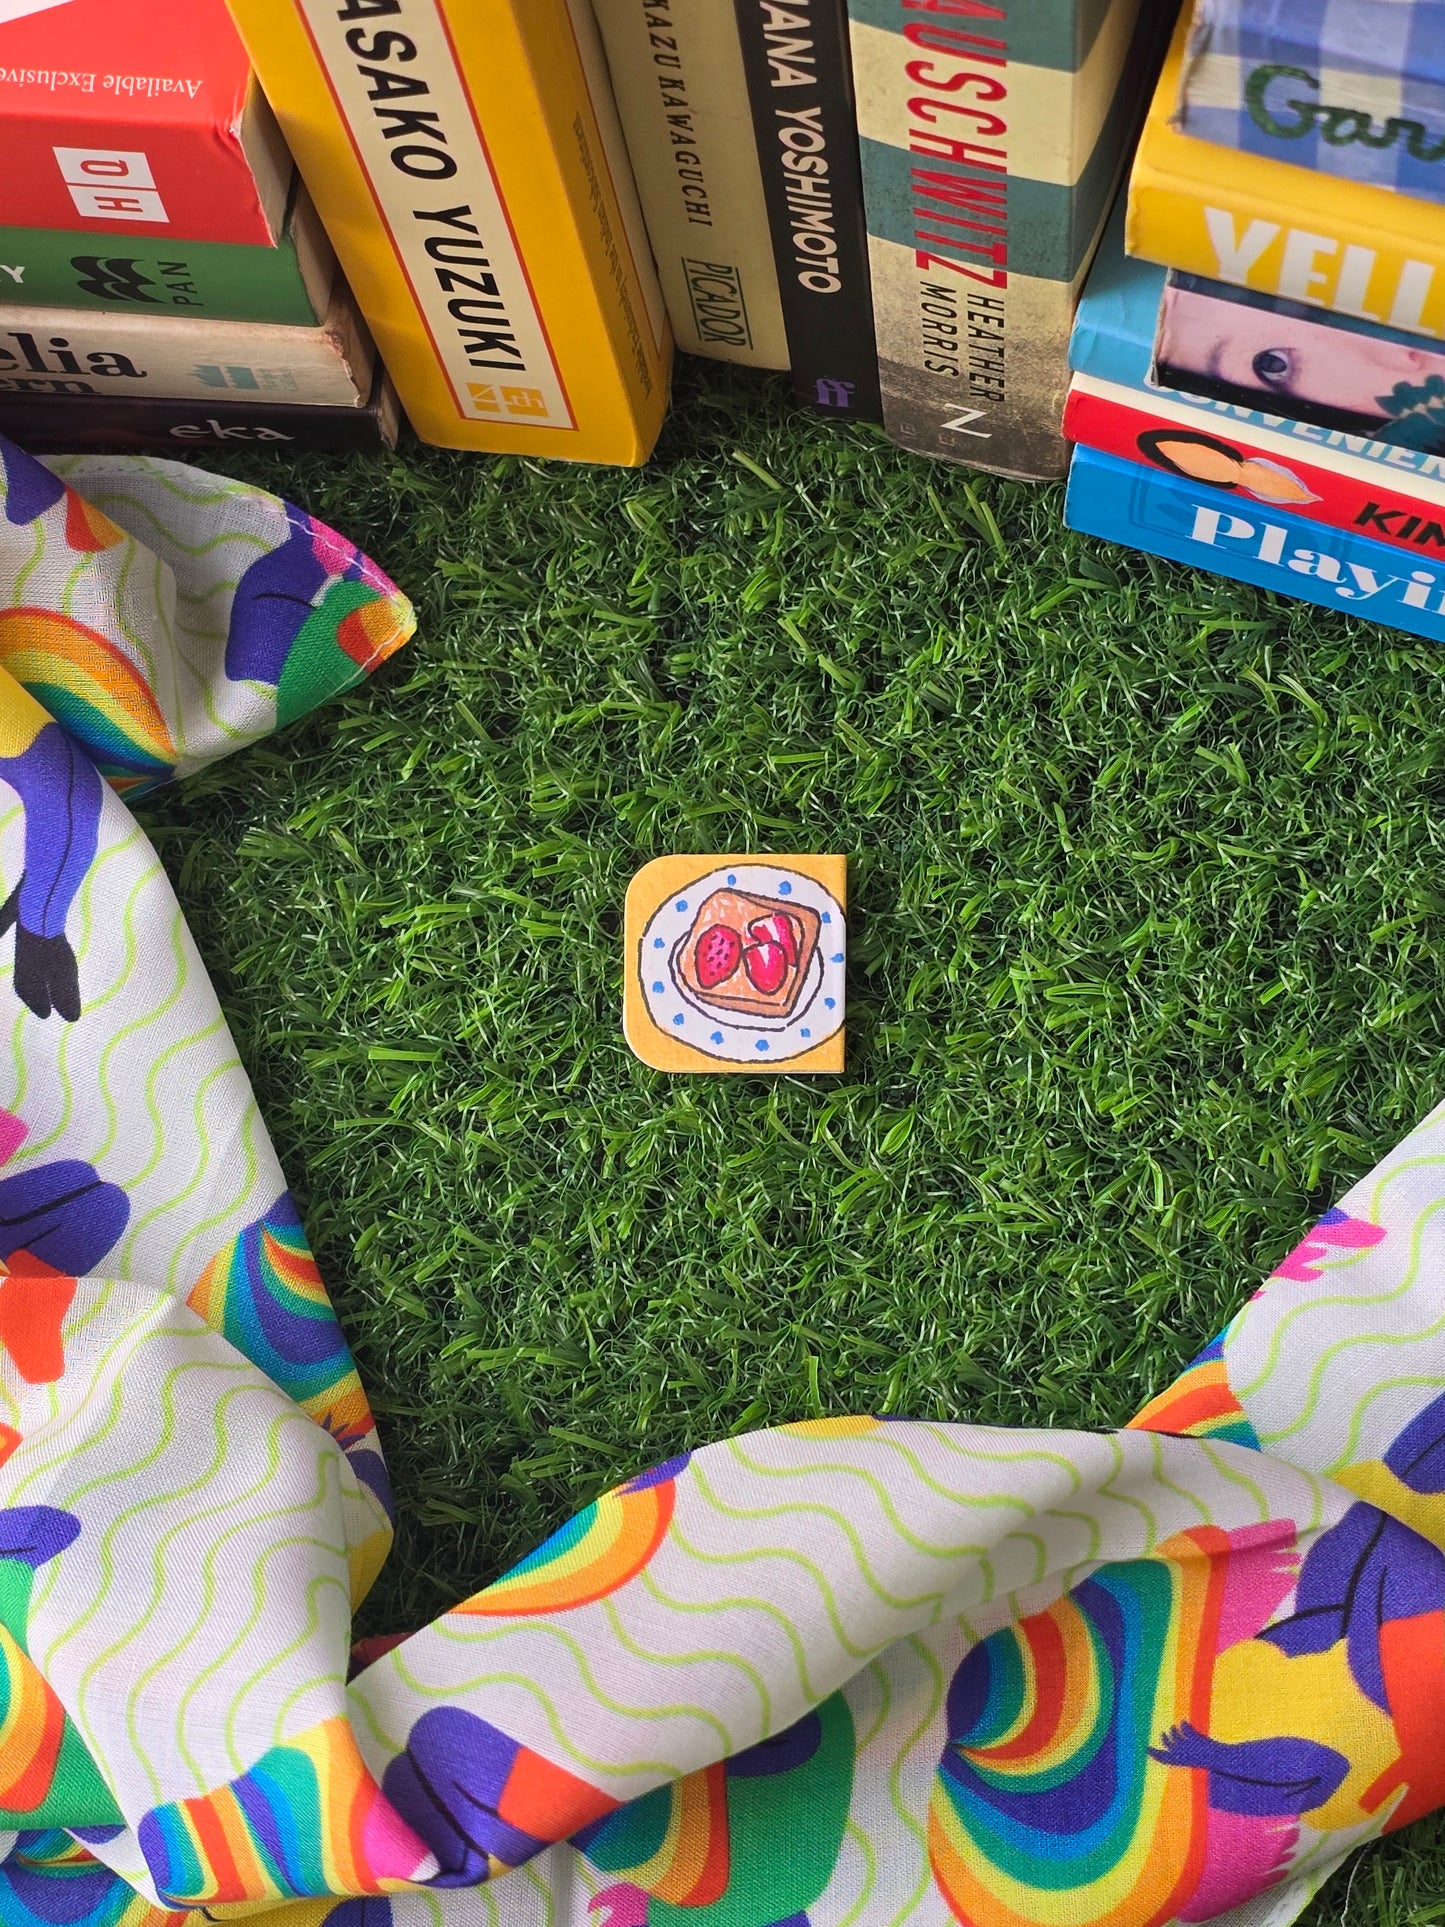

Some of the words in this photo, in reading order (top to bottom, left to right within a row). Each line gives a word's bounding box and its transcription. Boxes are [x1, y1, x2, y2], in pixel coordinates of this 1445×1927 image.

[0, 67, 97, 93] Exclusive
[103, 74, 203, 99] Available
[759, 0, 817, 87] ANA
[336, 0, 457, 180] ASAKO
[413, 205, 526, 371] YUZUKI
[658, 75, 713, 228] KAWAGUCHI
[902, 0, 1008, 289] AUSCHWITZ
[775, 107, 842, 294] YOSHIMOTO
[157, 260, 204, 307] PAN
[698, 258, 746, 348] PICADOR
[1203, 205, 1440, 337] YELL
[920, 281, 959, 377] MORRIS
[966, 292, 1006, 402] HEATHER
[169, 420, 295, 441] eka
[1185, 503, 1445, 617] Playi
